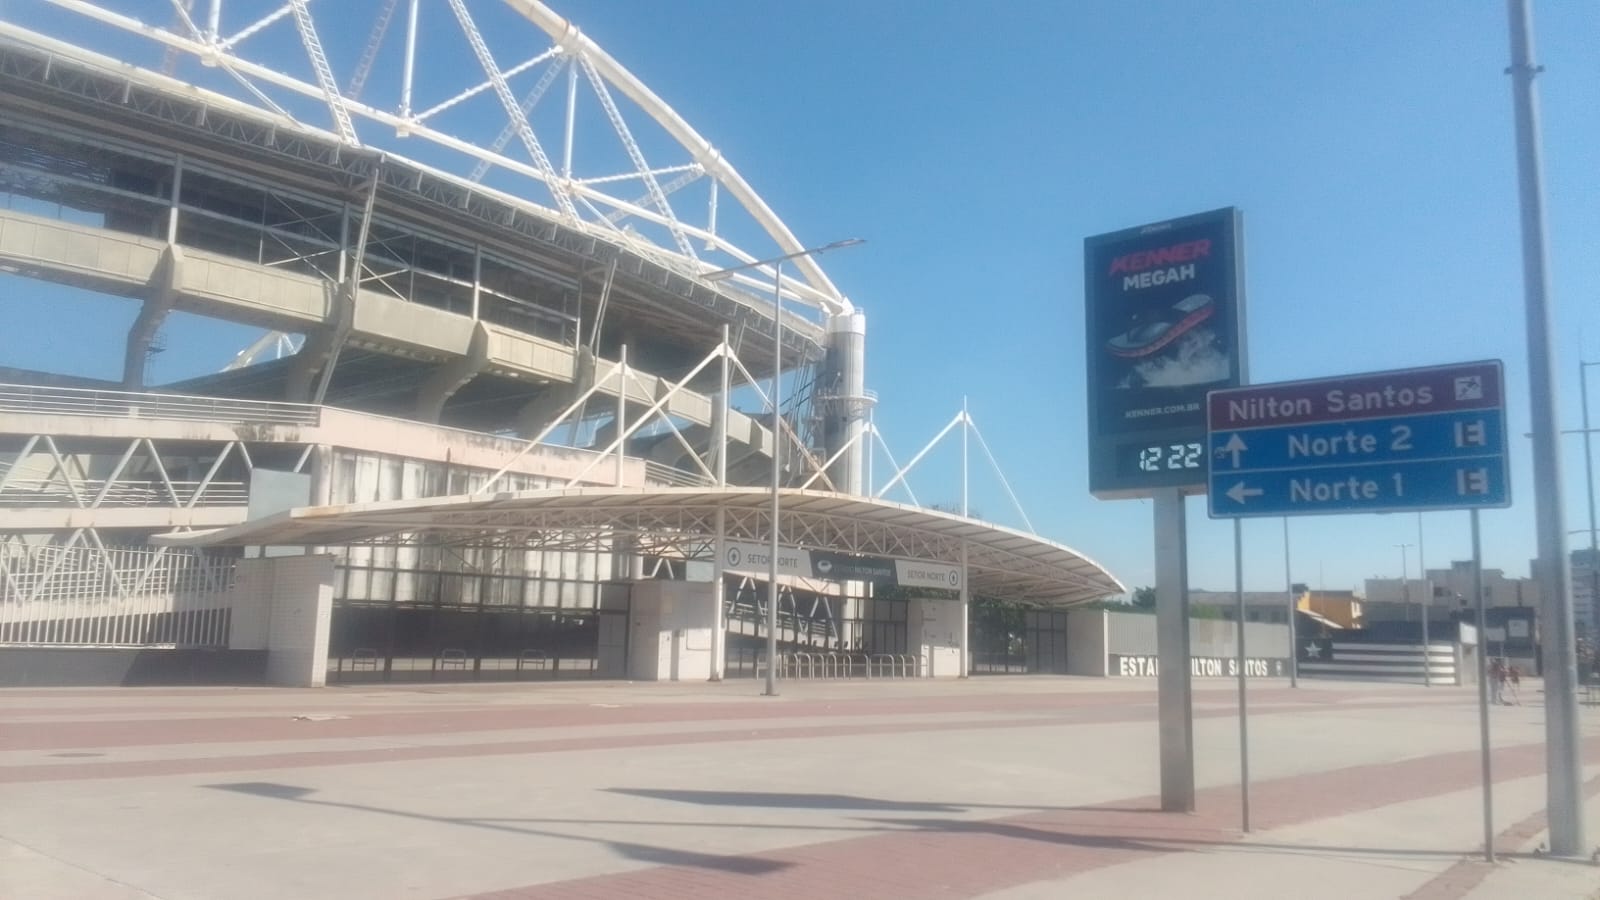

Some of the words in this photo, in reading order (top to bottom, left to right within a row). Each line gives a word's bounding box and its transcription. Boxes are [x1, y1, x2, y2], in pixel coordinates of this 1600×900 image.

[1109, 239, 1212, 276] KENNER
[1123, 263, 1195, 291] MEGAH
[1125, 403, 1200, 418] KENNER.COM.BR
[1229, 397, 1312, 421] Nilton
[1326, 385, 1433, 413] Santos
[1287, 430, 1377, 459] Norte
[1390, 424, 1413, 450] 2
[1289, 477, 1379, 502] Norte
[1391, 472, 1403, 497] 1
[778, 556, 799, 569] ORTE
[1191, 657, 1223, 677] ILTON
